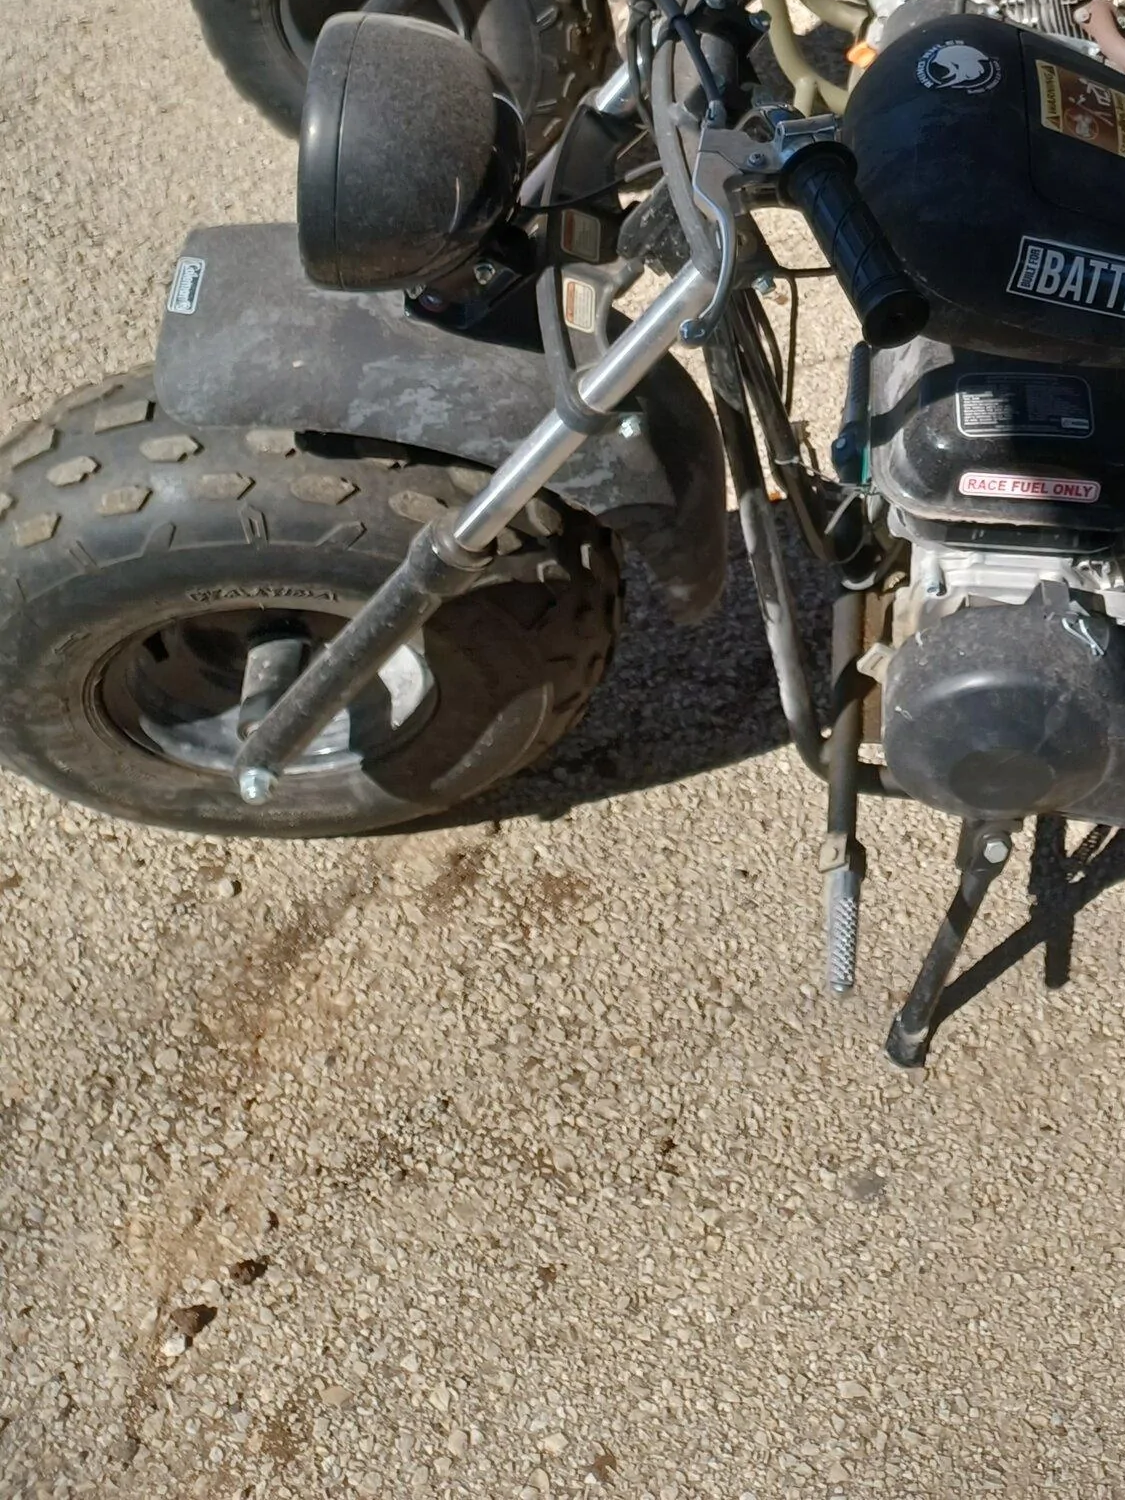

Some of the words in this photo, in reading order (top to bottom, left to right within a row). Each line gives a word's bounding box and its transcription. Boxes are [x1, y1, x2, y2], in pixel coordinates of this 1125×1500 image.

[1043, 70, 1057, 115] WARNING
[1021, 266, 1035, 288] BUILT
[1029, 247, 1041, 267] FOR
[967, 478, 1006, 491] RACE
[1011, 480, 1048, 494] FUEL
[1053, 483, 1093, 498] ONLY
